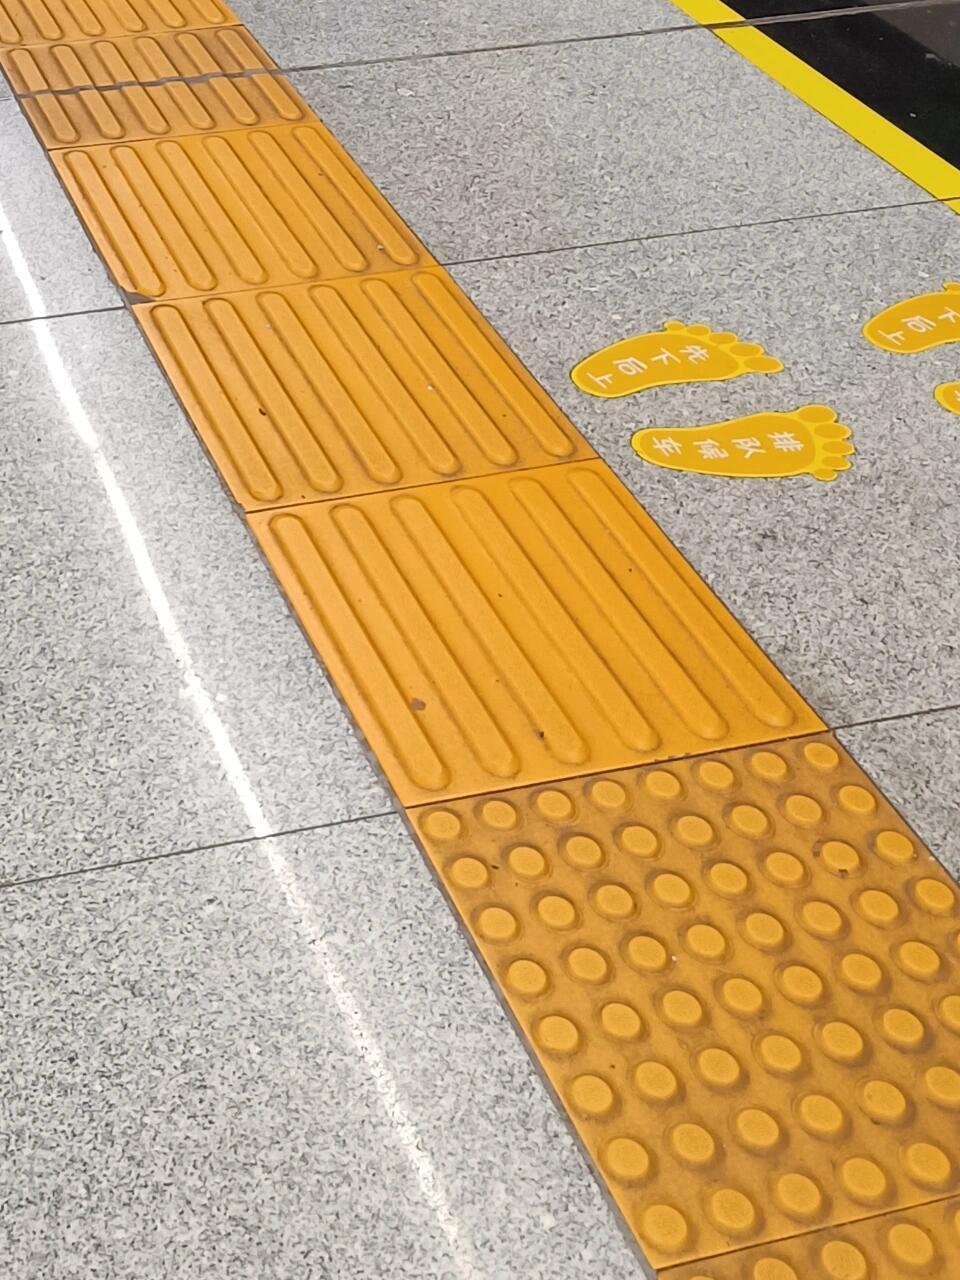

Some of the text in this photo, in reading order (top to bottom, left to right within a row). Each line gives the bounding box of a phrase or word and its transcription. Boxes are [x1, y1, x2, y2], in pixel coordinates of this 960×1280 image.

[586, 344, 710, 389] 先下后上
[651, 431, 805, 460] 排队候车
